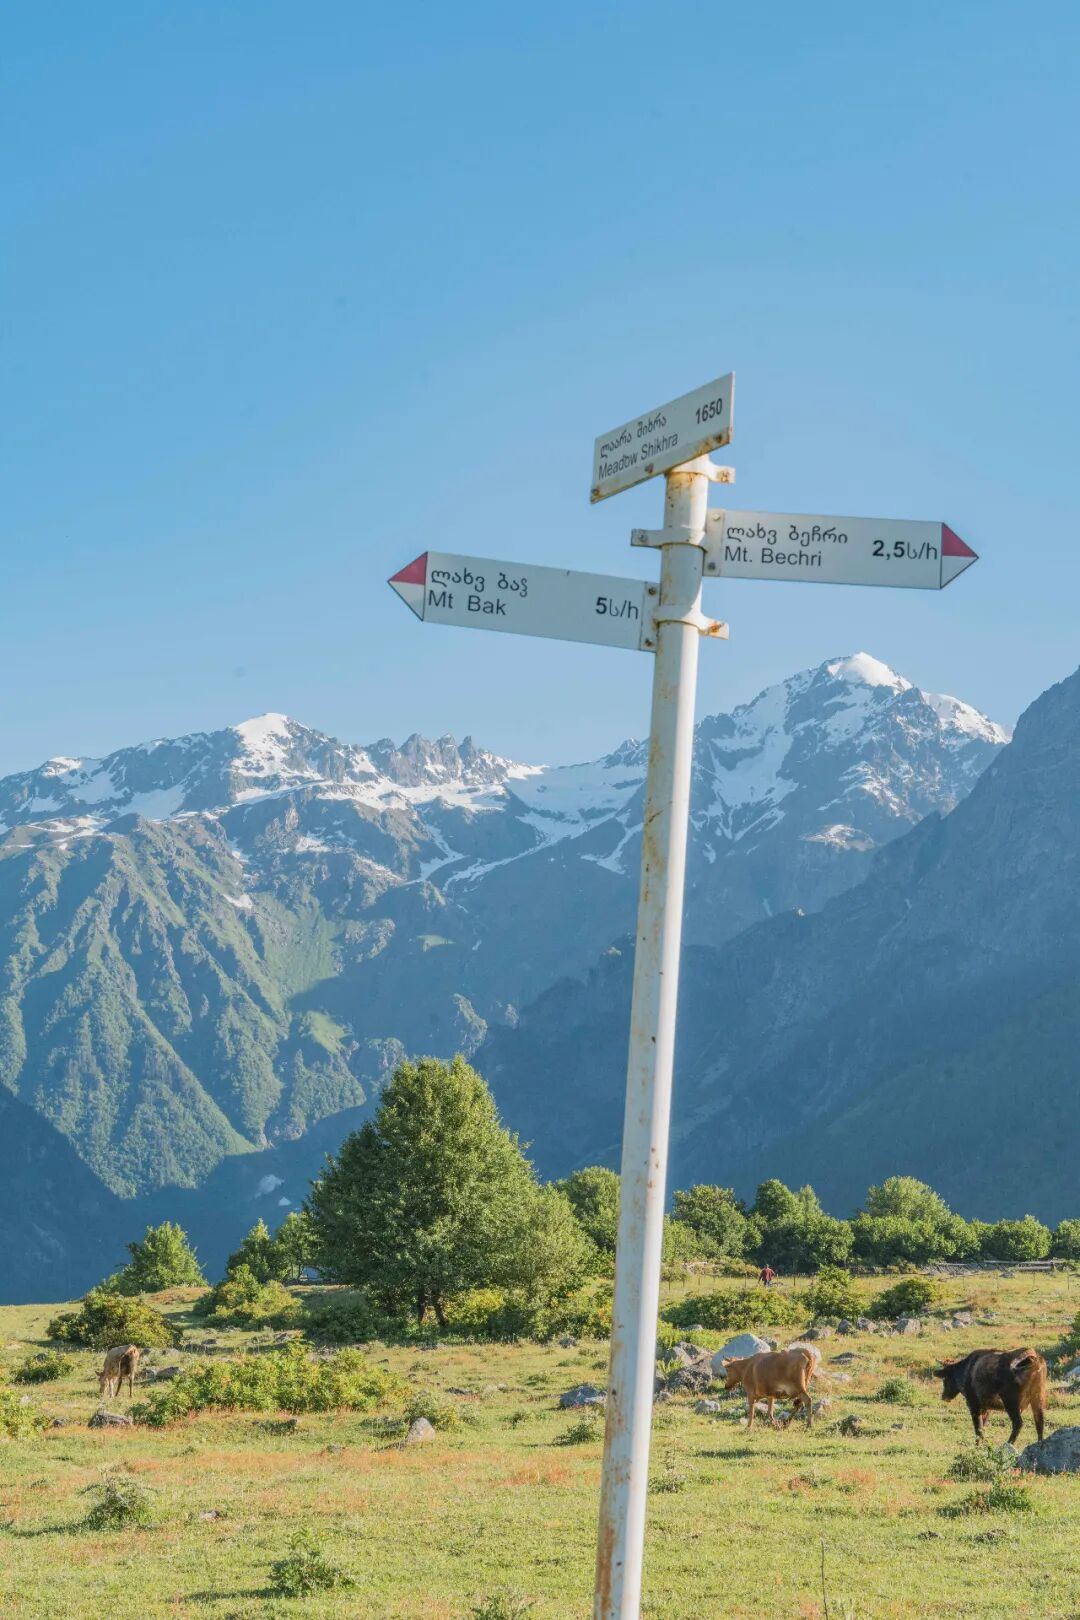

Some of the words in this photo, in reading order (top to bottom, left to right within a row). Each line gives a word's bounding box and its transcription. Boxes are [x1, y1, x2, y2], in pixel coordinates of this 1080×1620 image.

[695, 397, 723, 425] 1650
[598, 451, 638, 481] Meadow
[640, 433, 678, 461] Shikhra
[726, 522, 777, 545] ლახვ
[789, 524, 848, 547] ბეჩრი
[724, 545, 753, 563] Mt.
[761, 547, 822, 567] Bechri
[431, 567, 485, 593] ლახვ
[428, 589, 454, 609] Mt
[467, 595, 506, 616] Bak
